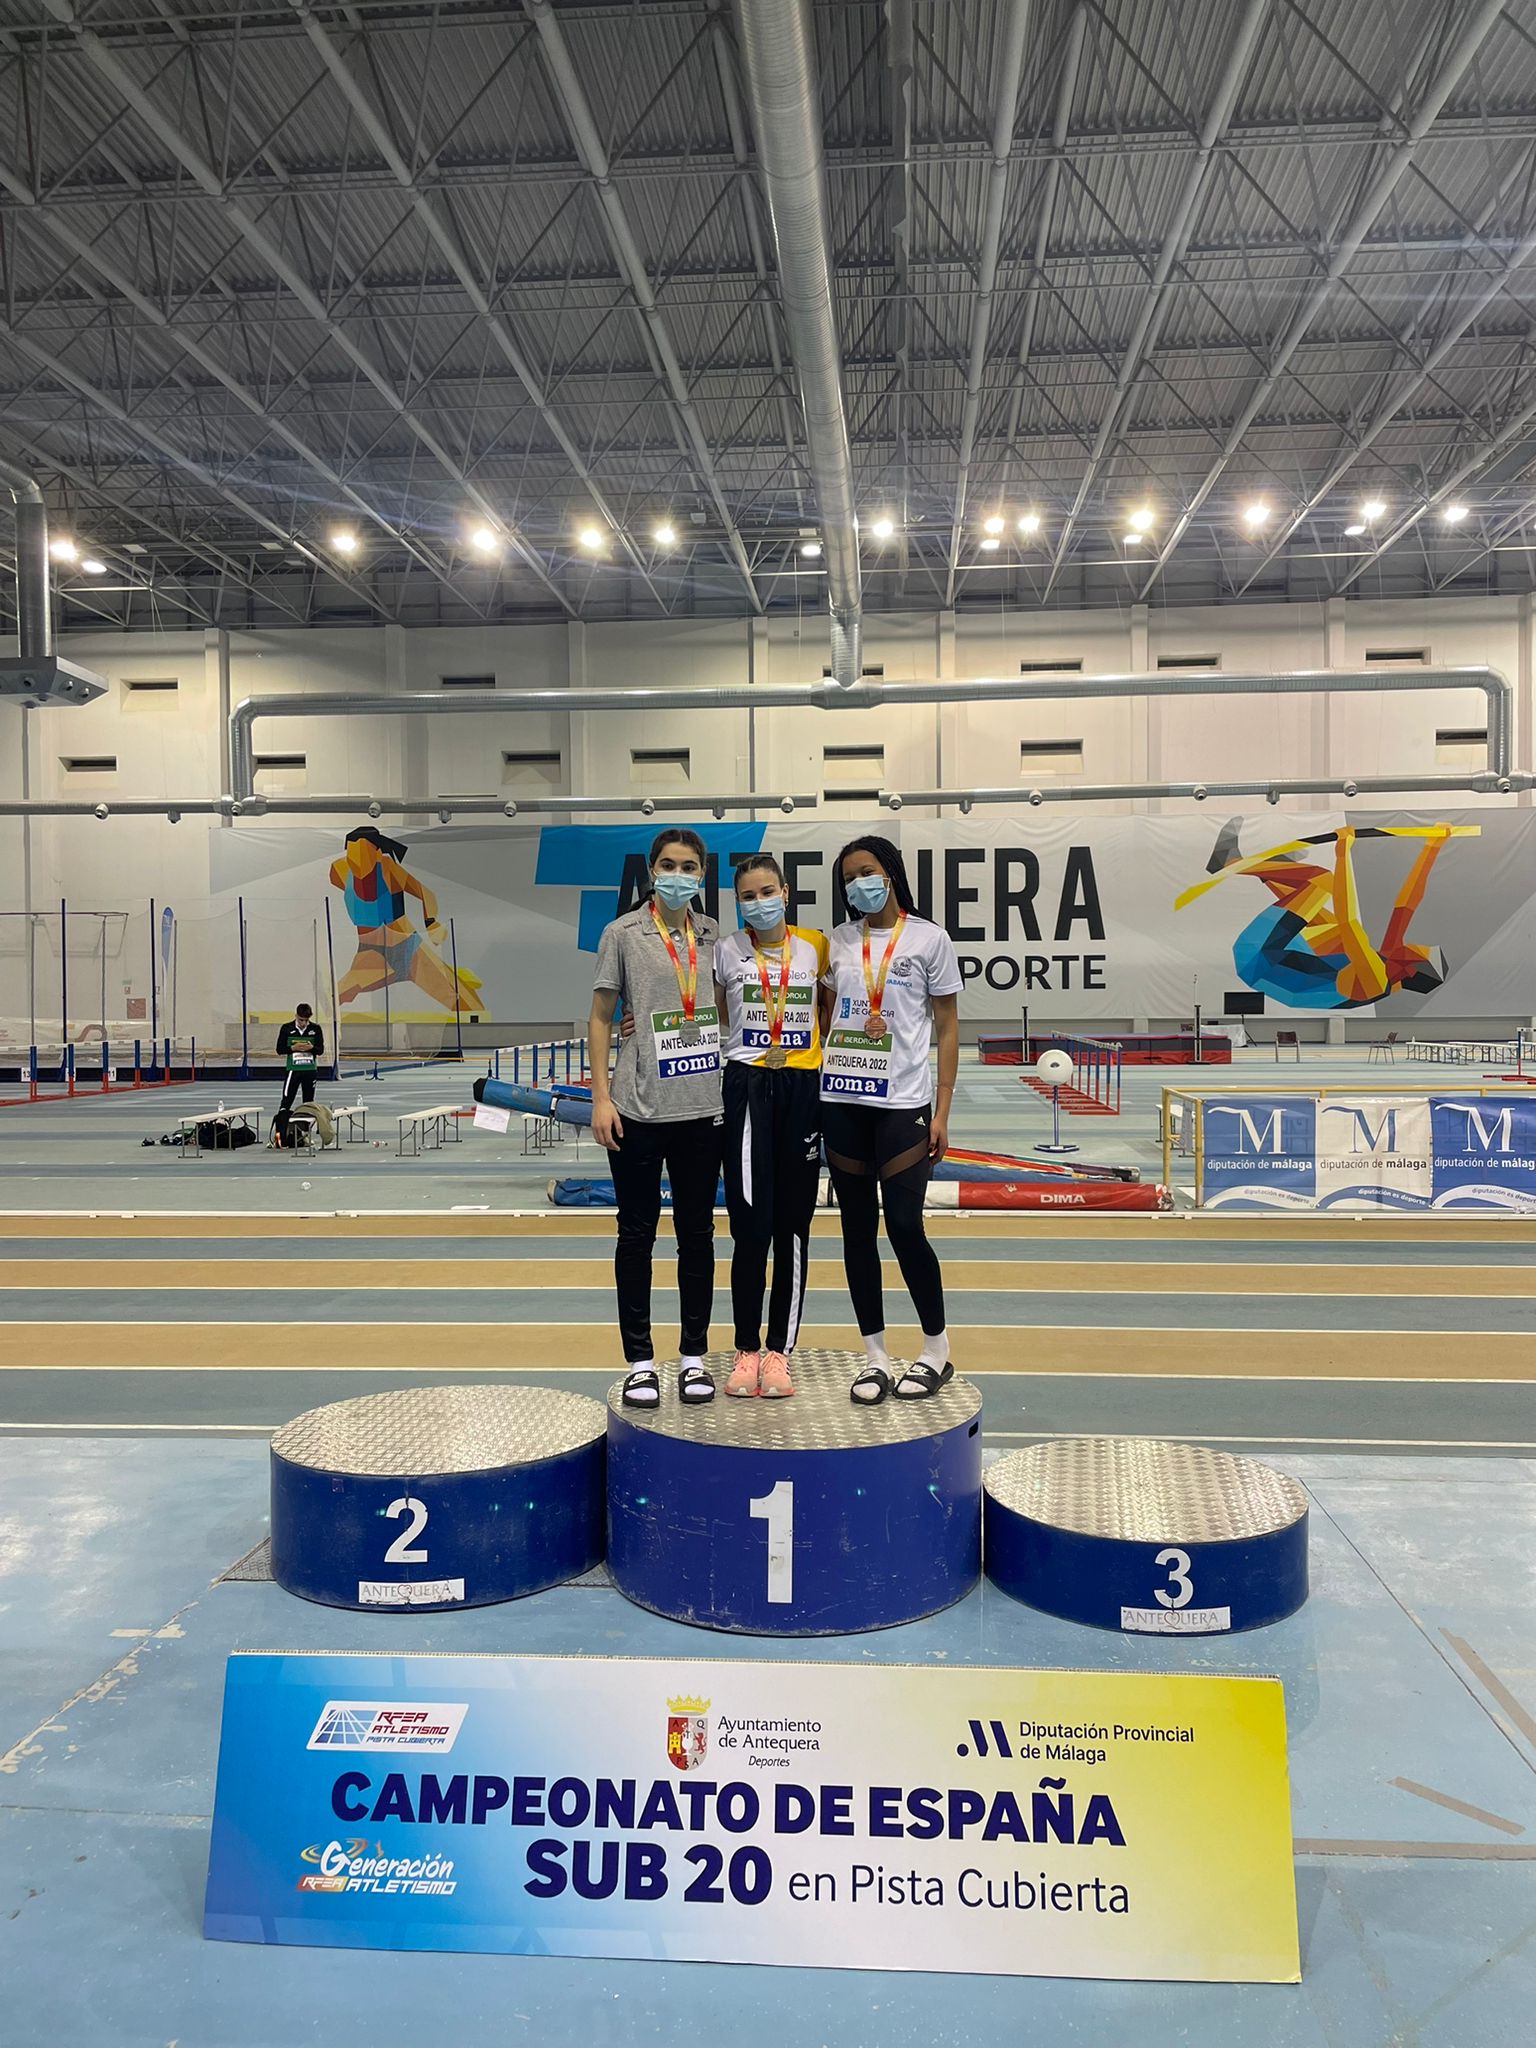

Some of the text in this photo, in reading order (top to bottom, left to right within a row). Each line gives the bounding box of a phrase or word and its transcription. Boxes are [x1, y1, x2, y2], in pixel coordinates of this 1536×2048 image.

[795, 1012, 810, 1023] 2022
[827, 1054, 888, 1070] ANTEQUERA 2022
[1207, 1159, 1312, 1171] diputación de málaga
[1320, 1158, 1427, 1171] diputación de málaga
[1434, 1157, 1536, 1171] diputación de málag
[1040, 1194, 1086, 1204] DIMA
[1358, 1188, 1391, 1197] diputación
[1400, 1193, 1426, 1205] deporte
[384, 1497, 428, 1563] 2
[750, 1481, 793, 1603] 1
[1153, 1548, 1194, 1609] 3
[377, 1711, 428, 1725] RFEA
[718, 1716, 822, 1734] Ayuntamiento
[372, 1725, 450, 1735] ATLETISMO
[1020, 1721, 1194, 1742] Diputación Provincial
[366, 1736, 445, 1745] PISTA CUBIERTA
[718, 1735, 820, 1753] de Antequera
[748, 1756, 790, 1768] Deportes
[1020, 1744, 1106, 1765] de Málaga
[332, 1771, 1127, 1846] CAMPEONATO DE ESPAÑA
[320, 1840, 455, 1879] Generación
[523, 1838, 1129, 1914] SUB 20 en Pista Cubierta
[346, 1878, 458, 1895] ATLETISMO
